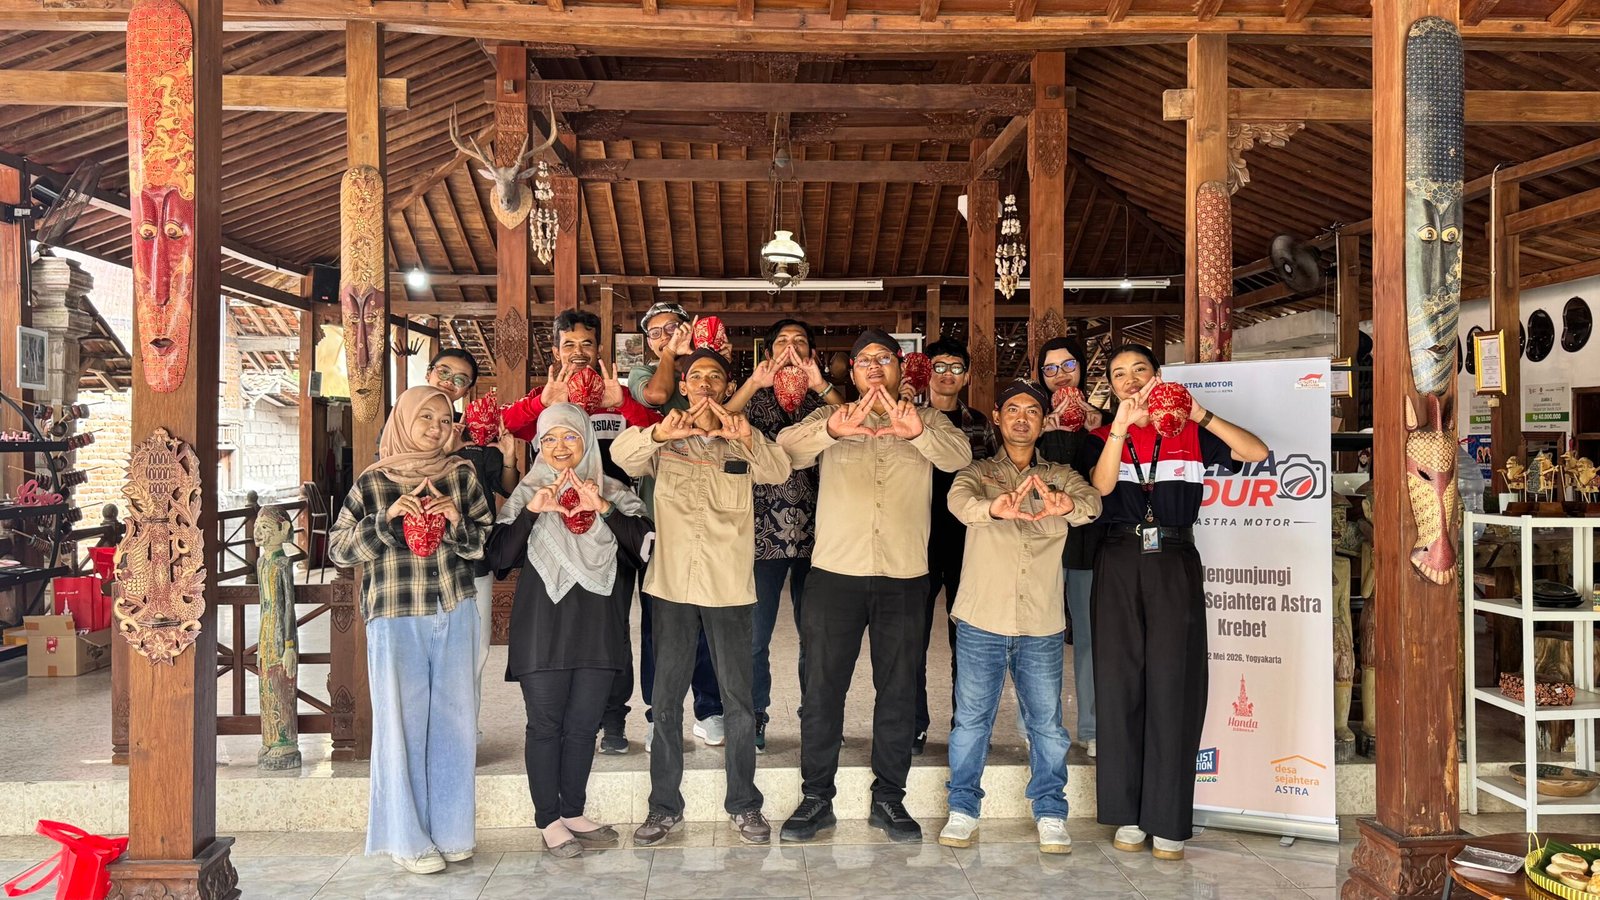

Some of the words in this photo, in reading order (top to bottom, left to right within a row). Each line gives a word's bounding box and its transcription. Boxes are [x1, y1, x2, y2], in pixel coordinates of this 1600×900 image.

[1200, 479, 1278, 507] OUR
[1194, 517, 1237, 526] ASTRA
[1243, 518, 1291, 527] MOTOR
[1204, 591, 1277, 612] Sejahtera
[1280, 594, 1322, 613] Astra
[1217, 618, 1267, 638] Krebet
[1212, 652, 1225, 661] Mei
[1226, 653, 1245, 663] 2026,
[1245, 654, 1282, 664] Yogyakarta
[1227, 716, 1258, 729] Honda
[1196, 751, 1214, 762] LIST
[1274, 764, 1297, 774] desa
[1196, 775, 1217, 783] 2026
[1274, 774, 1320, 786] sejahtera
[1274, 785, 1309, 796] ASTRA
